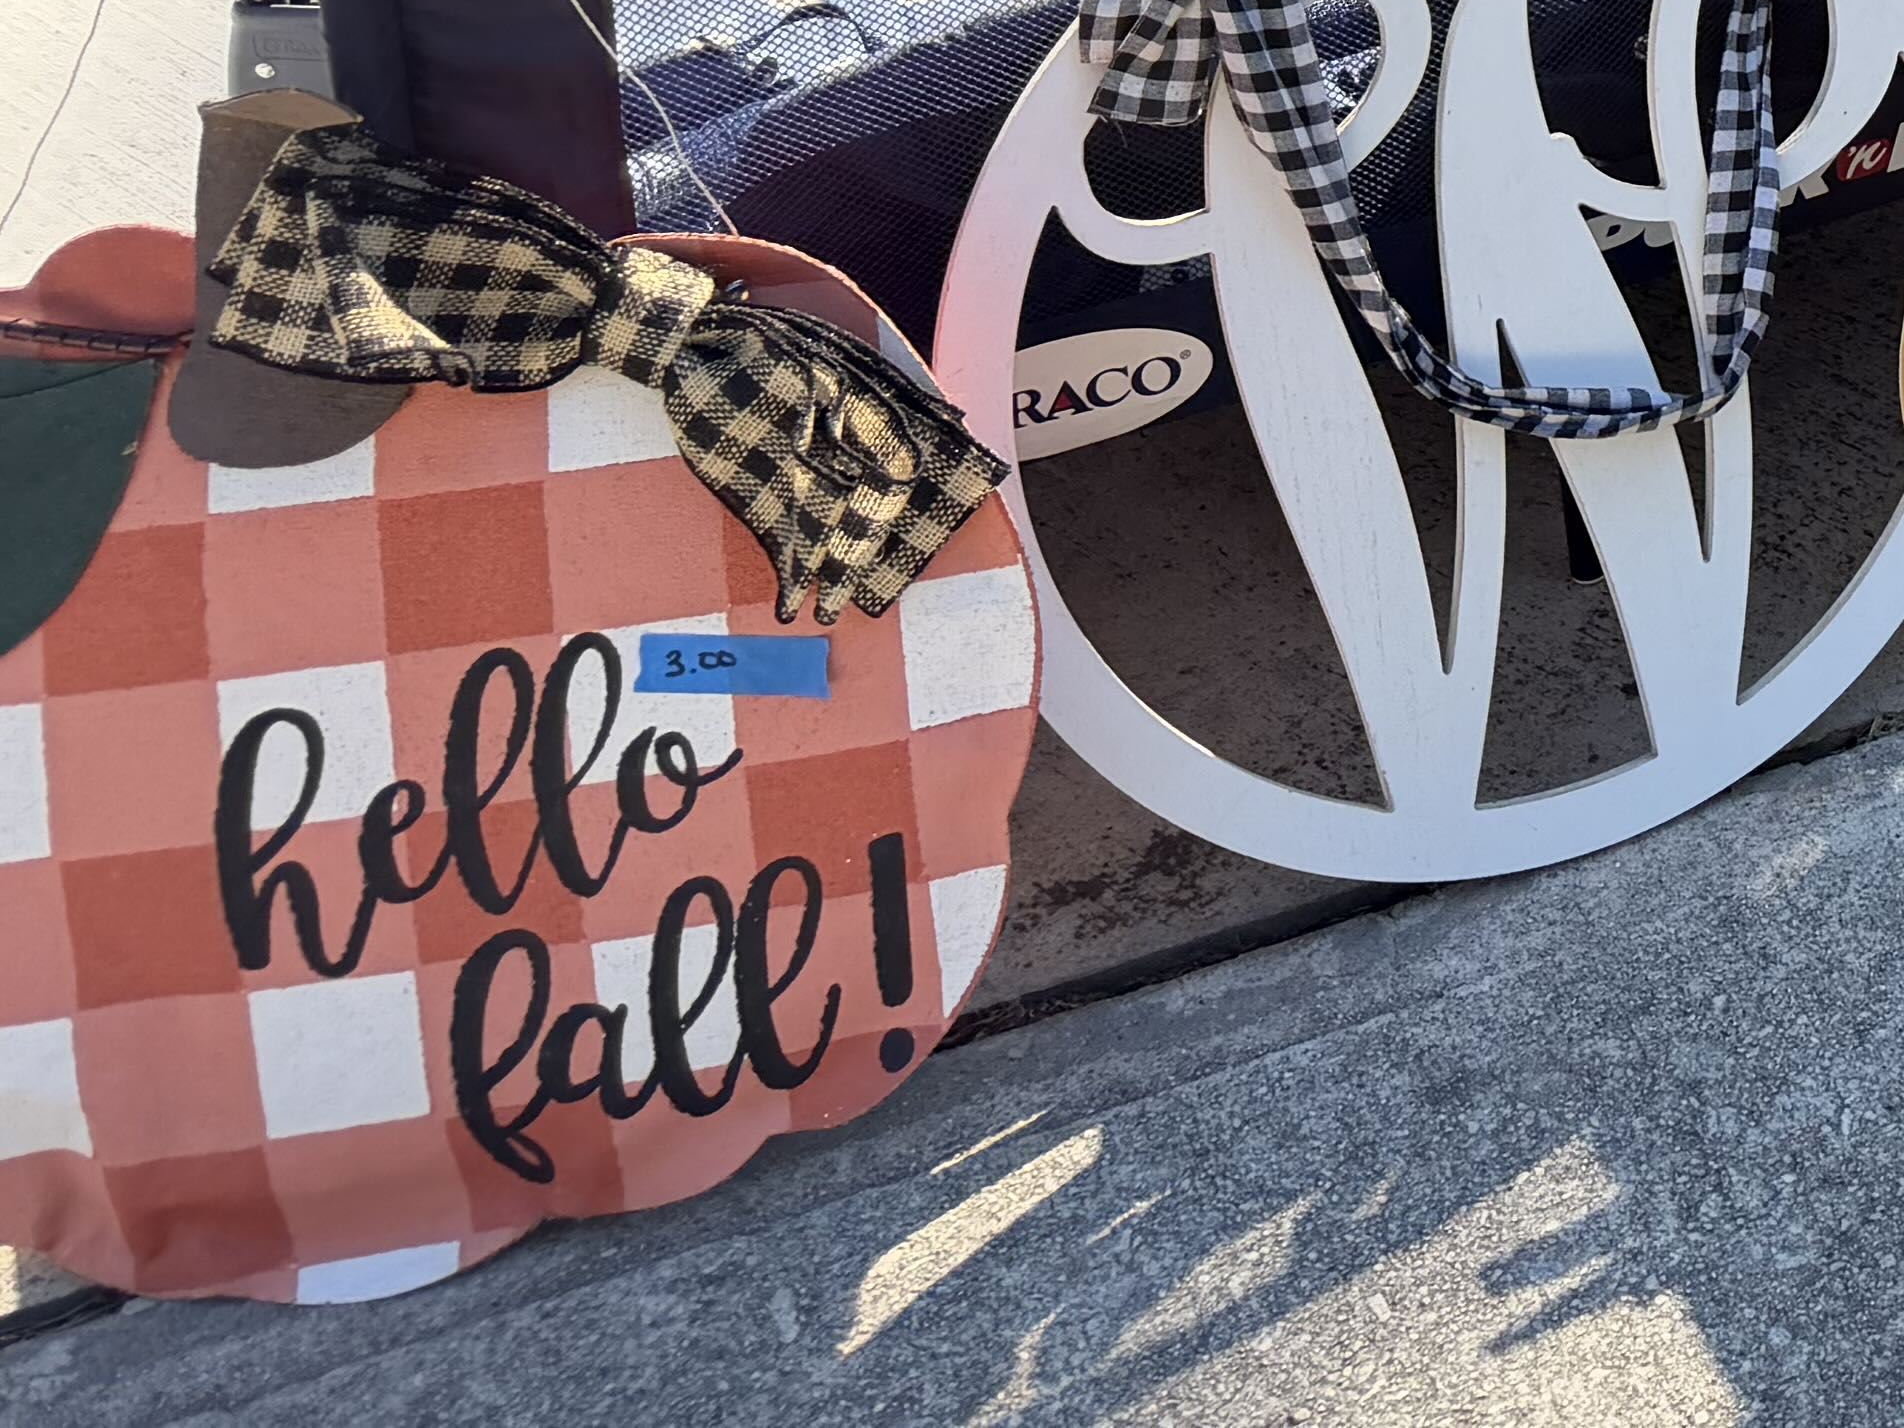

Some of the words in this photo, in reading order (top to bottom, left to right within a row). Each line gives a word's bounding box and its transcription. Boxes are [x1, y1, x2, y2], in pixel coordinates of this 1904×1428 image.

[1012, 356, 1182, 429] RACO
[214, 630, 745, 978] hello
[450, 830, 916, 1186] fall!
